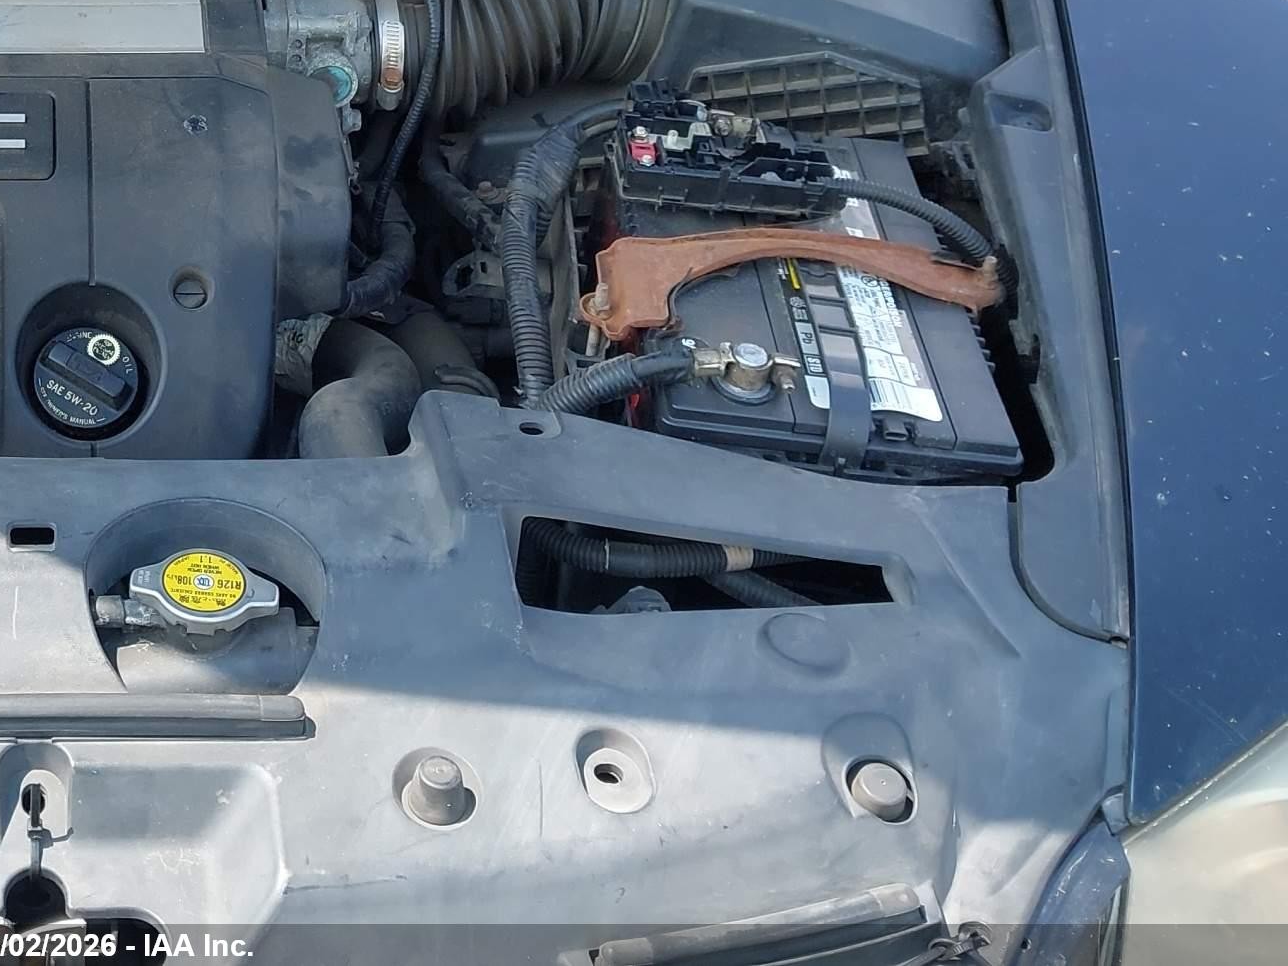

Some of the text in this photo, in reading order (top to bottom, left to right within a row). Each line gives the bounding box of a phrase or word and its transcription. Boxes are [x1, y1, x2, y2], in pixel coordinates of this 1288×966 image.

[800, 331, 815, 344] Pb
[122, 356, 133, 374] OIL
[46, 379, 98, 416] SAE 5W-20
[217, 579, 242, 590] R126
